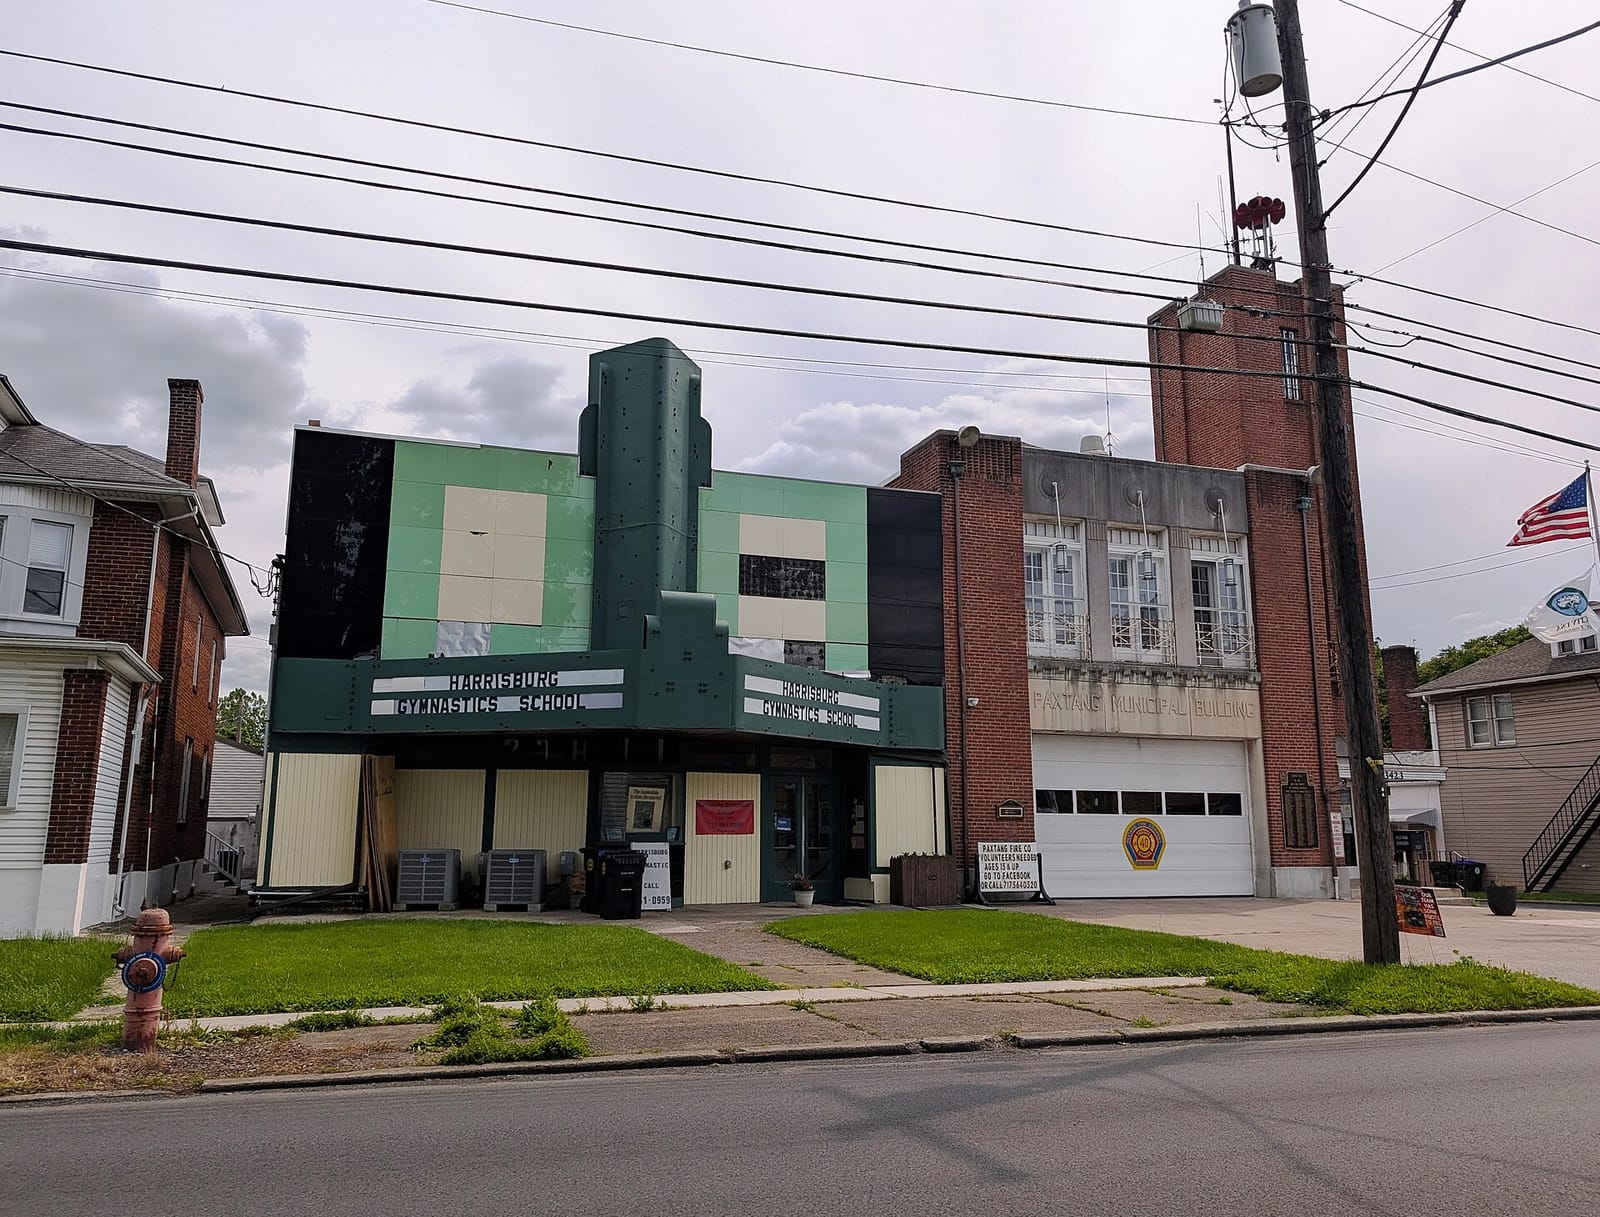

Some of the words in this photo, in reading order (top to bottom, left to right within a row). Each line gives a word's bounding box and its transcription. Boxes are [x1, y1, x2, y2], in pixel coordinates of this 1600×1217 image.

[451, 671, 558, 691] HARRISBURG
[783, 680, 839, 705] HARRISBURG
[398, 696, 498, 715] GYMNASTICS
[520, 693, 586, 713] SCHOOL
[763, 700, 819, 723] GYMNASTICS
[827, 709, 858, 728] SCHOOL
[1033, 690, 1100, 712] PAXTANG
[1110, 695, 1187, 716] MUNICIPAL
[1194, 699, 1254, 719] BUILDING
[1384, 771, 1404, 780] 3423
[981, 881, 988, 890] OR
[988, 881, 1003, 889] CALL
[984, 872, 991, 880] GO
[993, 872, 1001, 880] TO
[1002, 872, 1031, 880] FACEBOOK
[643, 895, 671, 905] 1-0959
